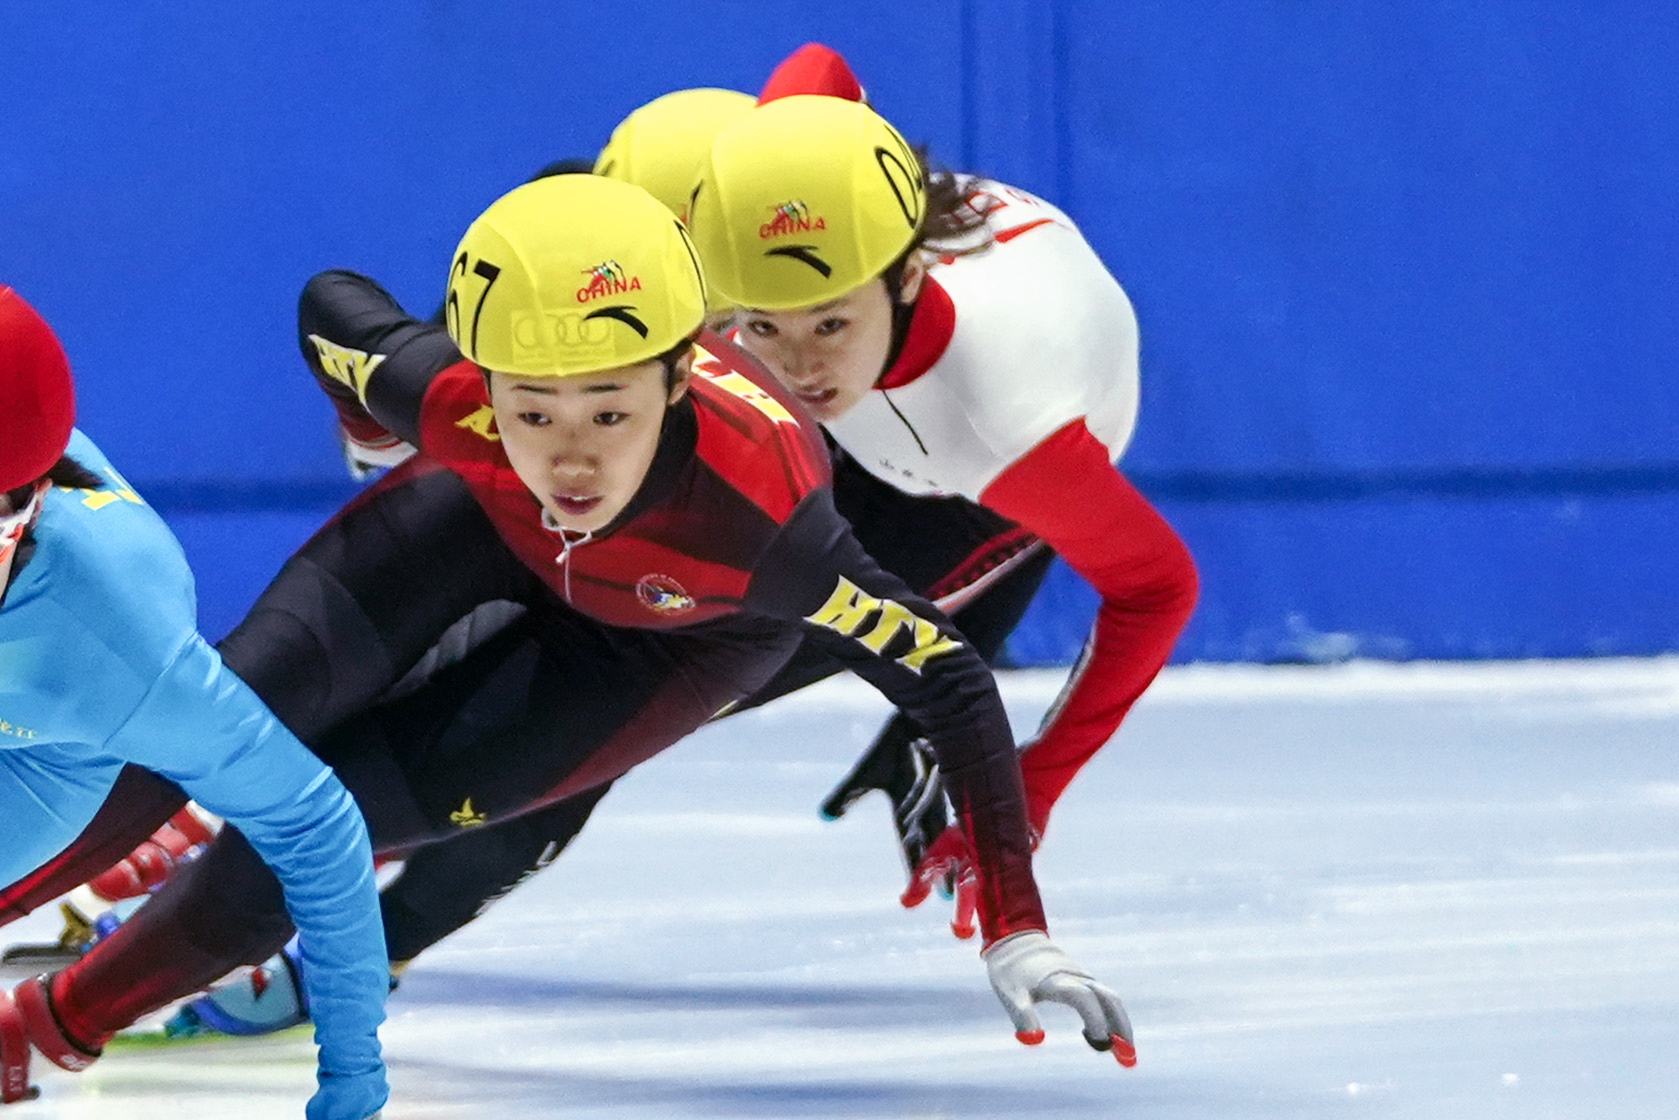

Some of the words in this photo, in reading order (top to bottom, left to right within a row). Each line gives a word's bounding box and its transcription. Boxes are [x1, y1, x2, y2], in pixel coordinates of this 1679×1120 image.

[759, 216, 827, 240] CHINA
[576, 276, 642, 304] CHINA
[802, 574, 964, 677] HTY
